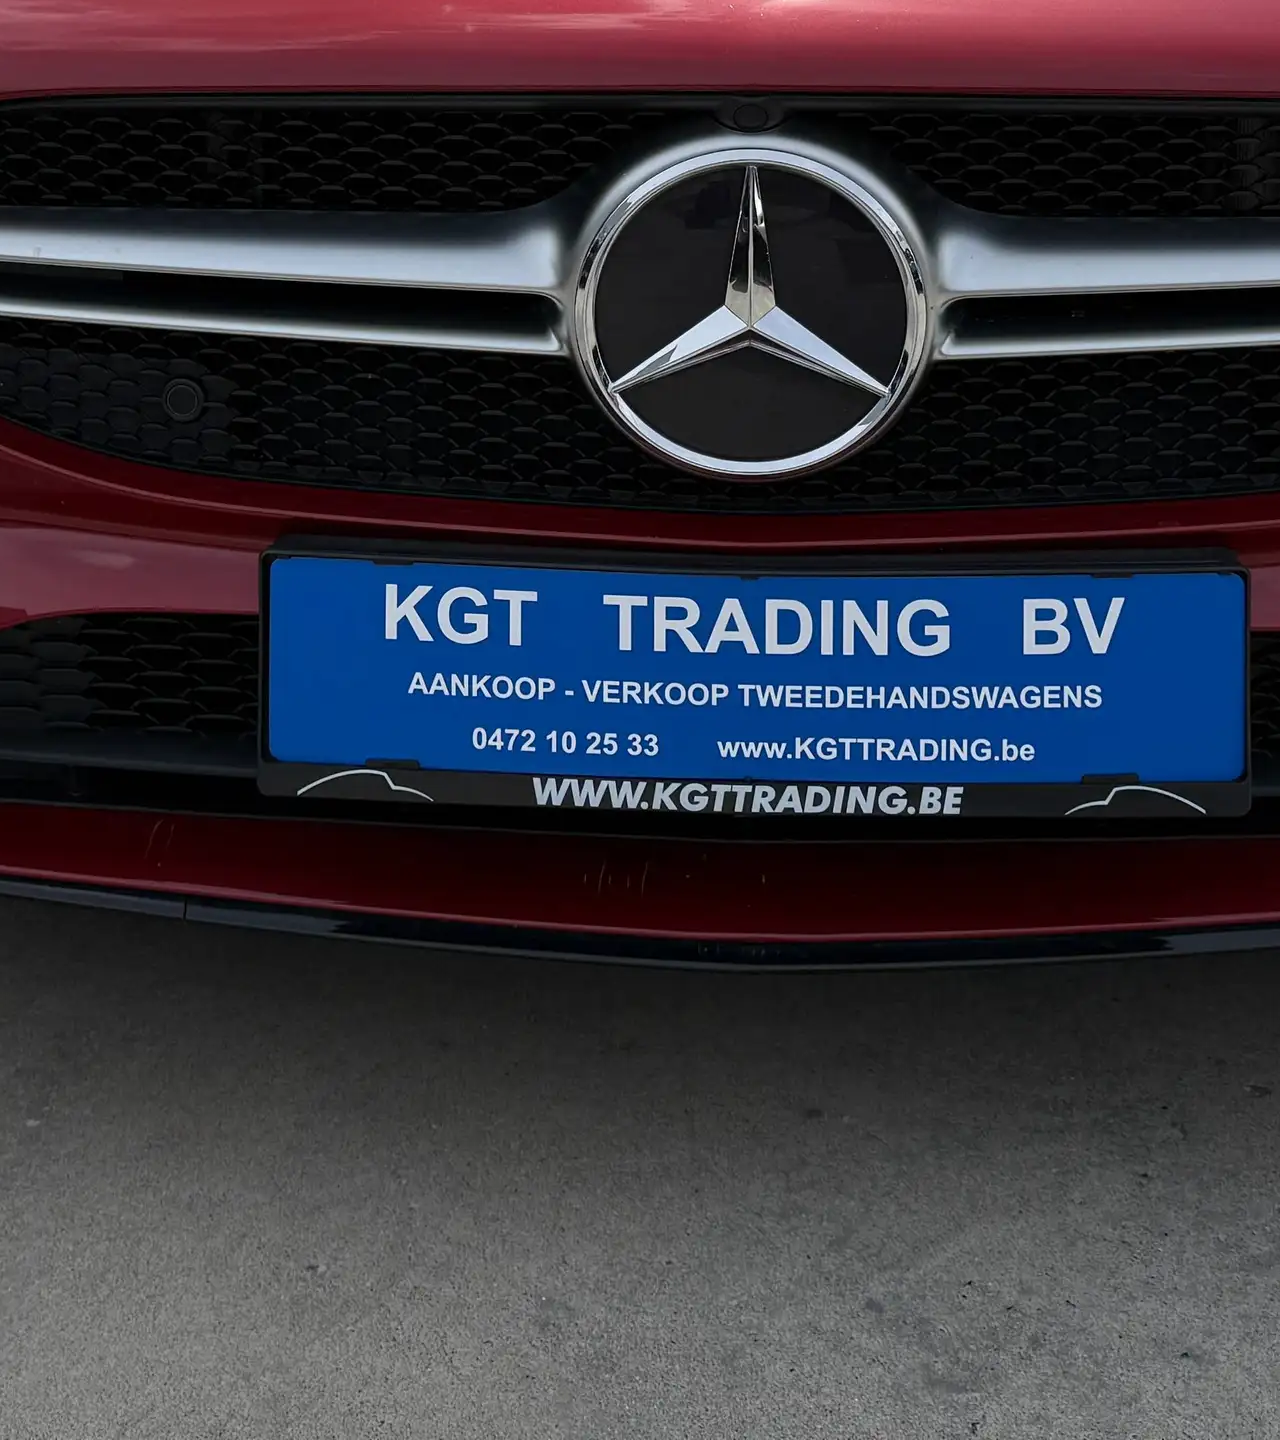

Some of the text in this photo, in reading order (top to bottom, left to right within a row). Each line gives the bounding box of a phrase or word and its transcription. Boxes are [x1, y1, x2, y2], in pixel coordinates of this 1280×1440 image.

[384, 583, 1126, 657] KGT TRADING BV
[407, 671, 556, 700] AANKOOP
[581, 679, 729, 707] VERKOOP
[737, 684, 1103, 709] TWEEDEHANDSWAGENS
[472, 727, 1035, 762] 0472 10 25 33 www.KGTTRADING.be
[532, 777, 964, 815] WWW.KGTTRADING.BE
